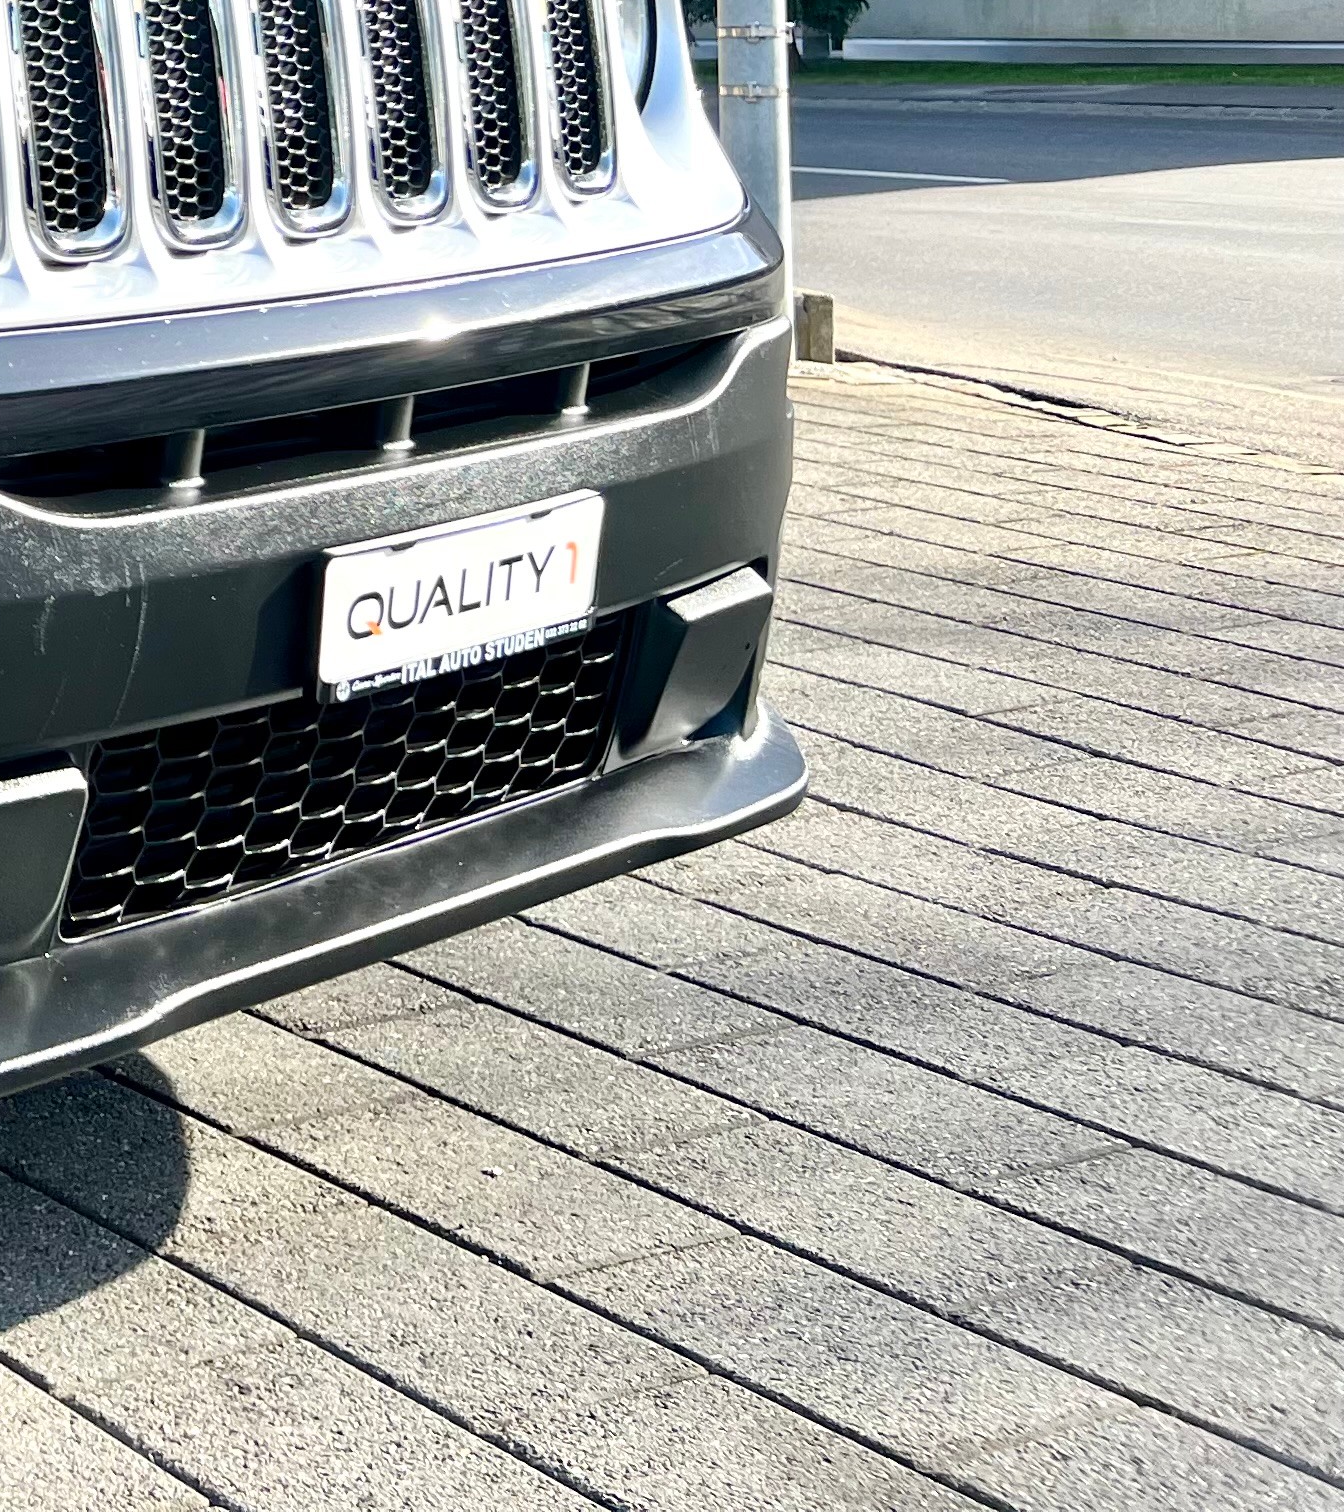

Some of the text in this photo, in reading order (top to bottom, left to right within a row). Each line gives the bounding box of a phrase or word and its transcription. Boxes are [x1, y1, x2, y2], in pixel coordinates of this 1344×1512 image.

[346, 540, 578, 640] QUALITY 1
[400, 656, 437, 685] ITAL
[438, 644, 482, 675] AUTO
[484, 626, 545, 662] STUDEN
